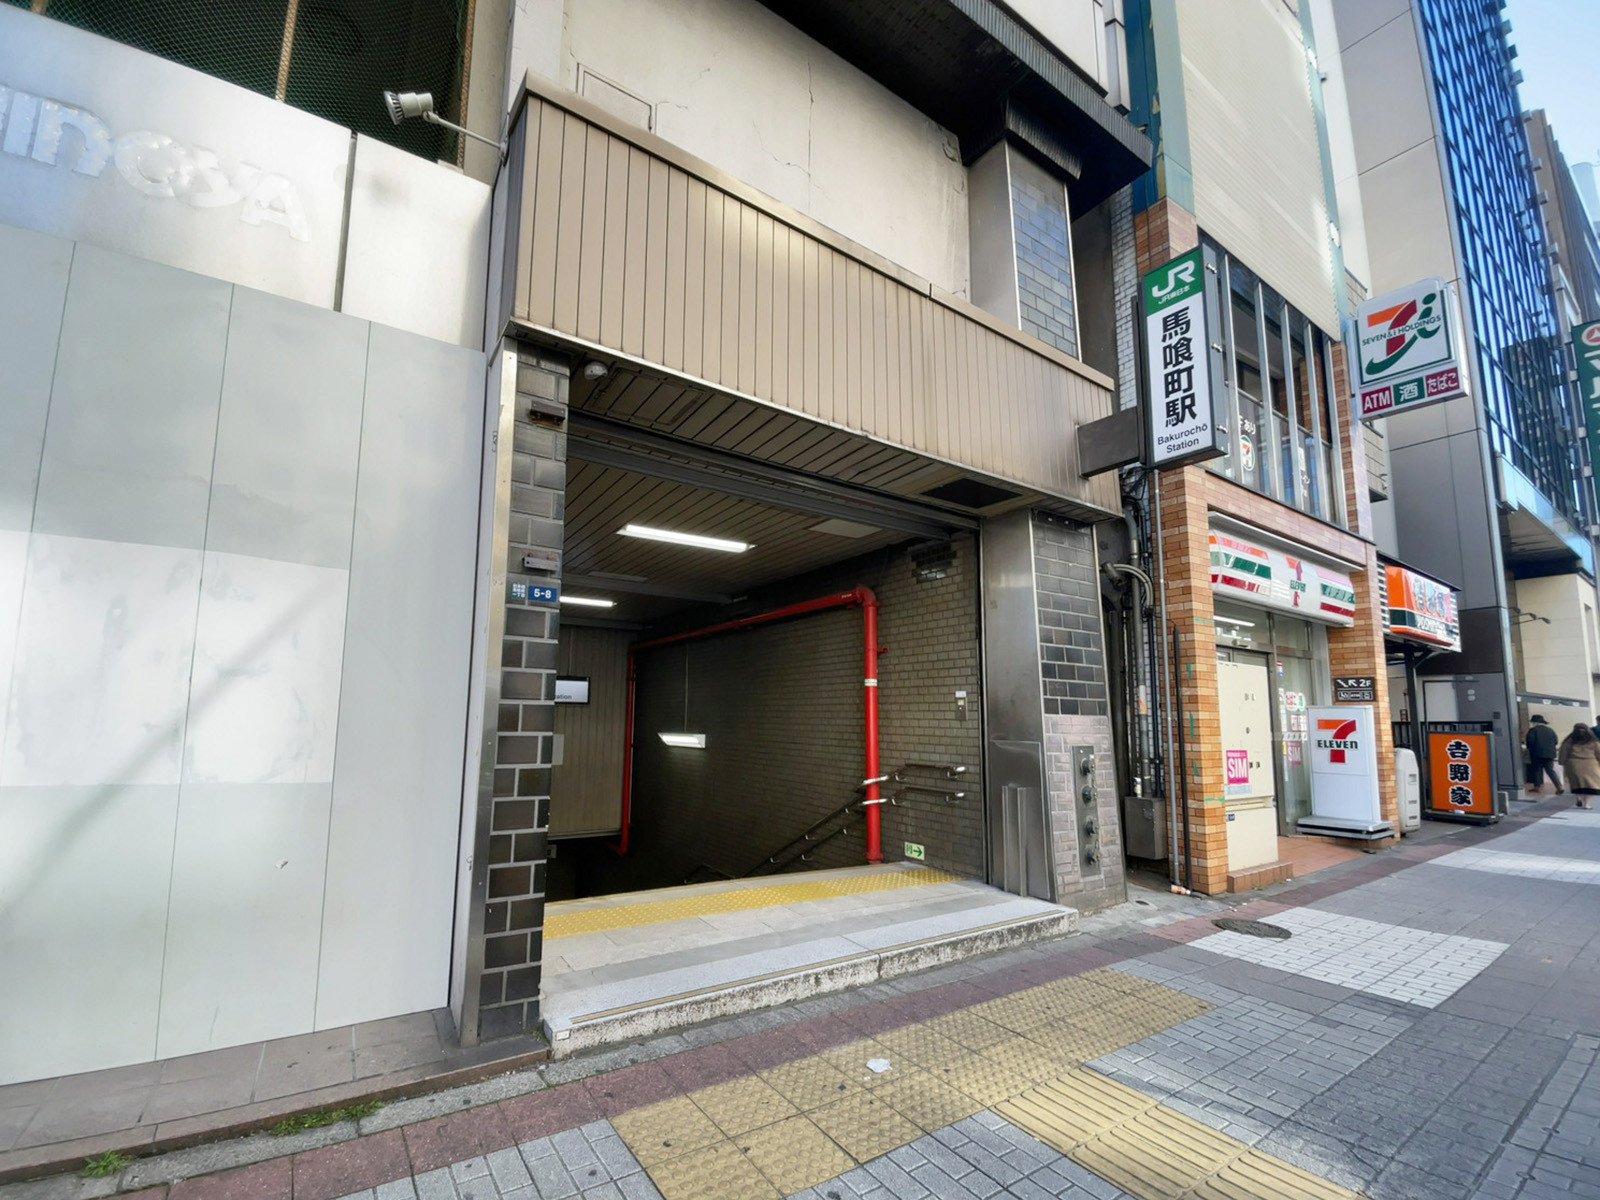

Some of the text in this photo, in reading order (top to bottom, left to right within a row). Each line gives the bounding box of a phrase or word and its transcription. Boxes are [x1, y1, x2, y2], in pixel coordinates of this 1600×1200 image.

[1152, 260, 1195, 297] JR
[1158, 284, 1190, 304] JR東日本
[1398, 315, 1442, 334] HOLDINGS
[1161, 305, 1197, 428] 馬喰町駅
[1399, 382, 1418, 402] 酒
[1427, 372, 1459, 394] たばこ
[1364, 389, 1391, 412] ATM
[1166, 436, 1199, 454] Station
[533, 588, 552, 599] 5-8
[1360, 679, 1371, 688] 2F
[1317, 719, 1357, 764] 7
[1228, 758, 1247, 779] SIM
[1445, 739, 1473, 807] 吉野家
